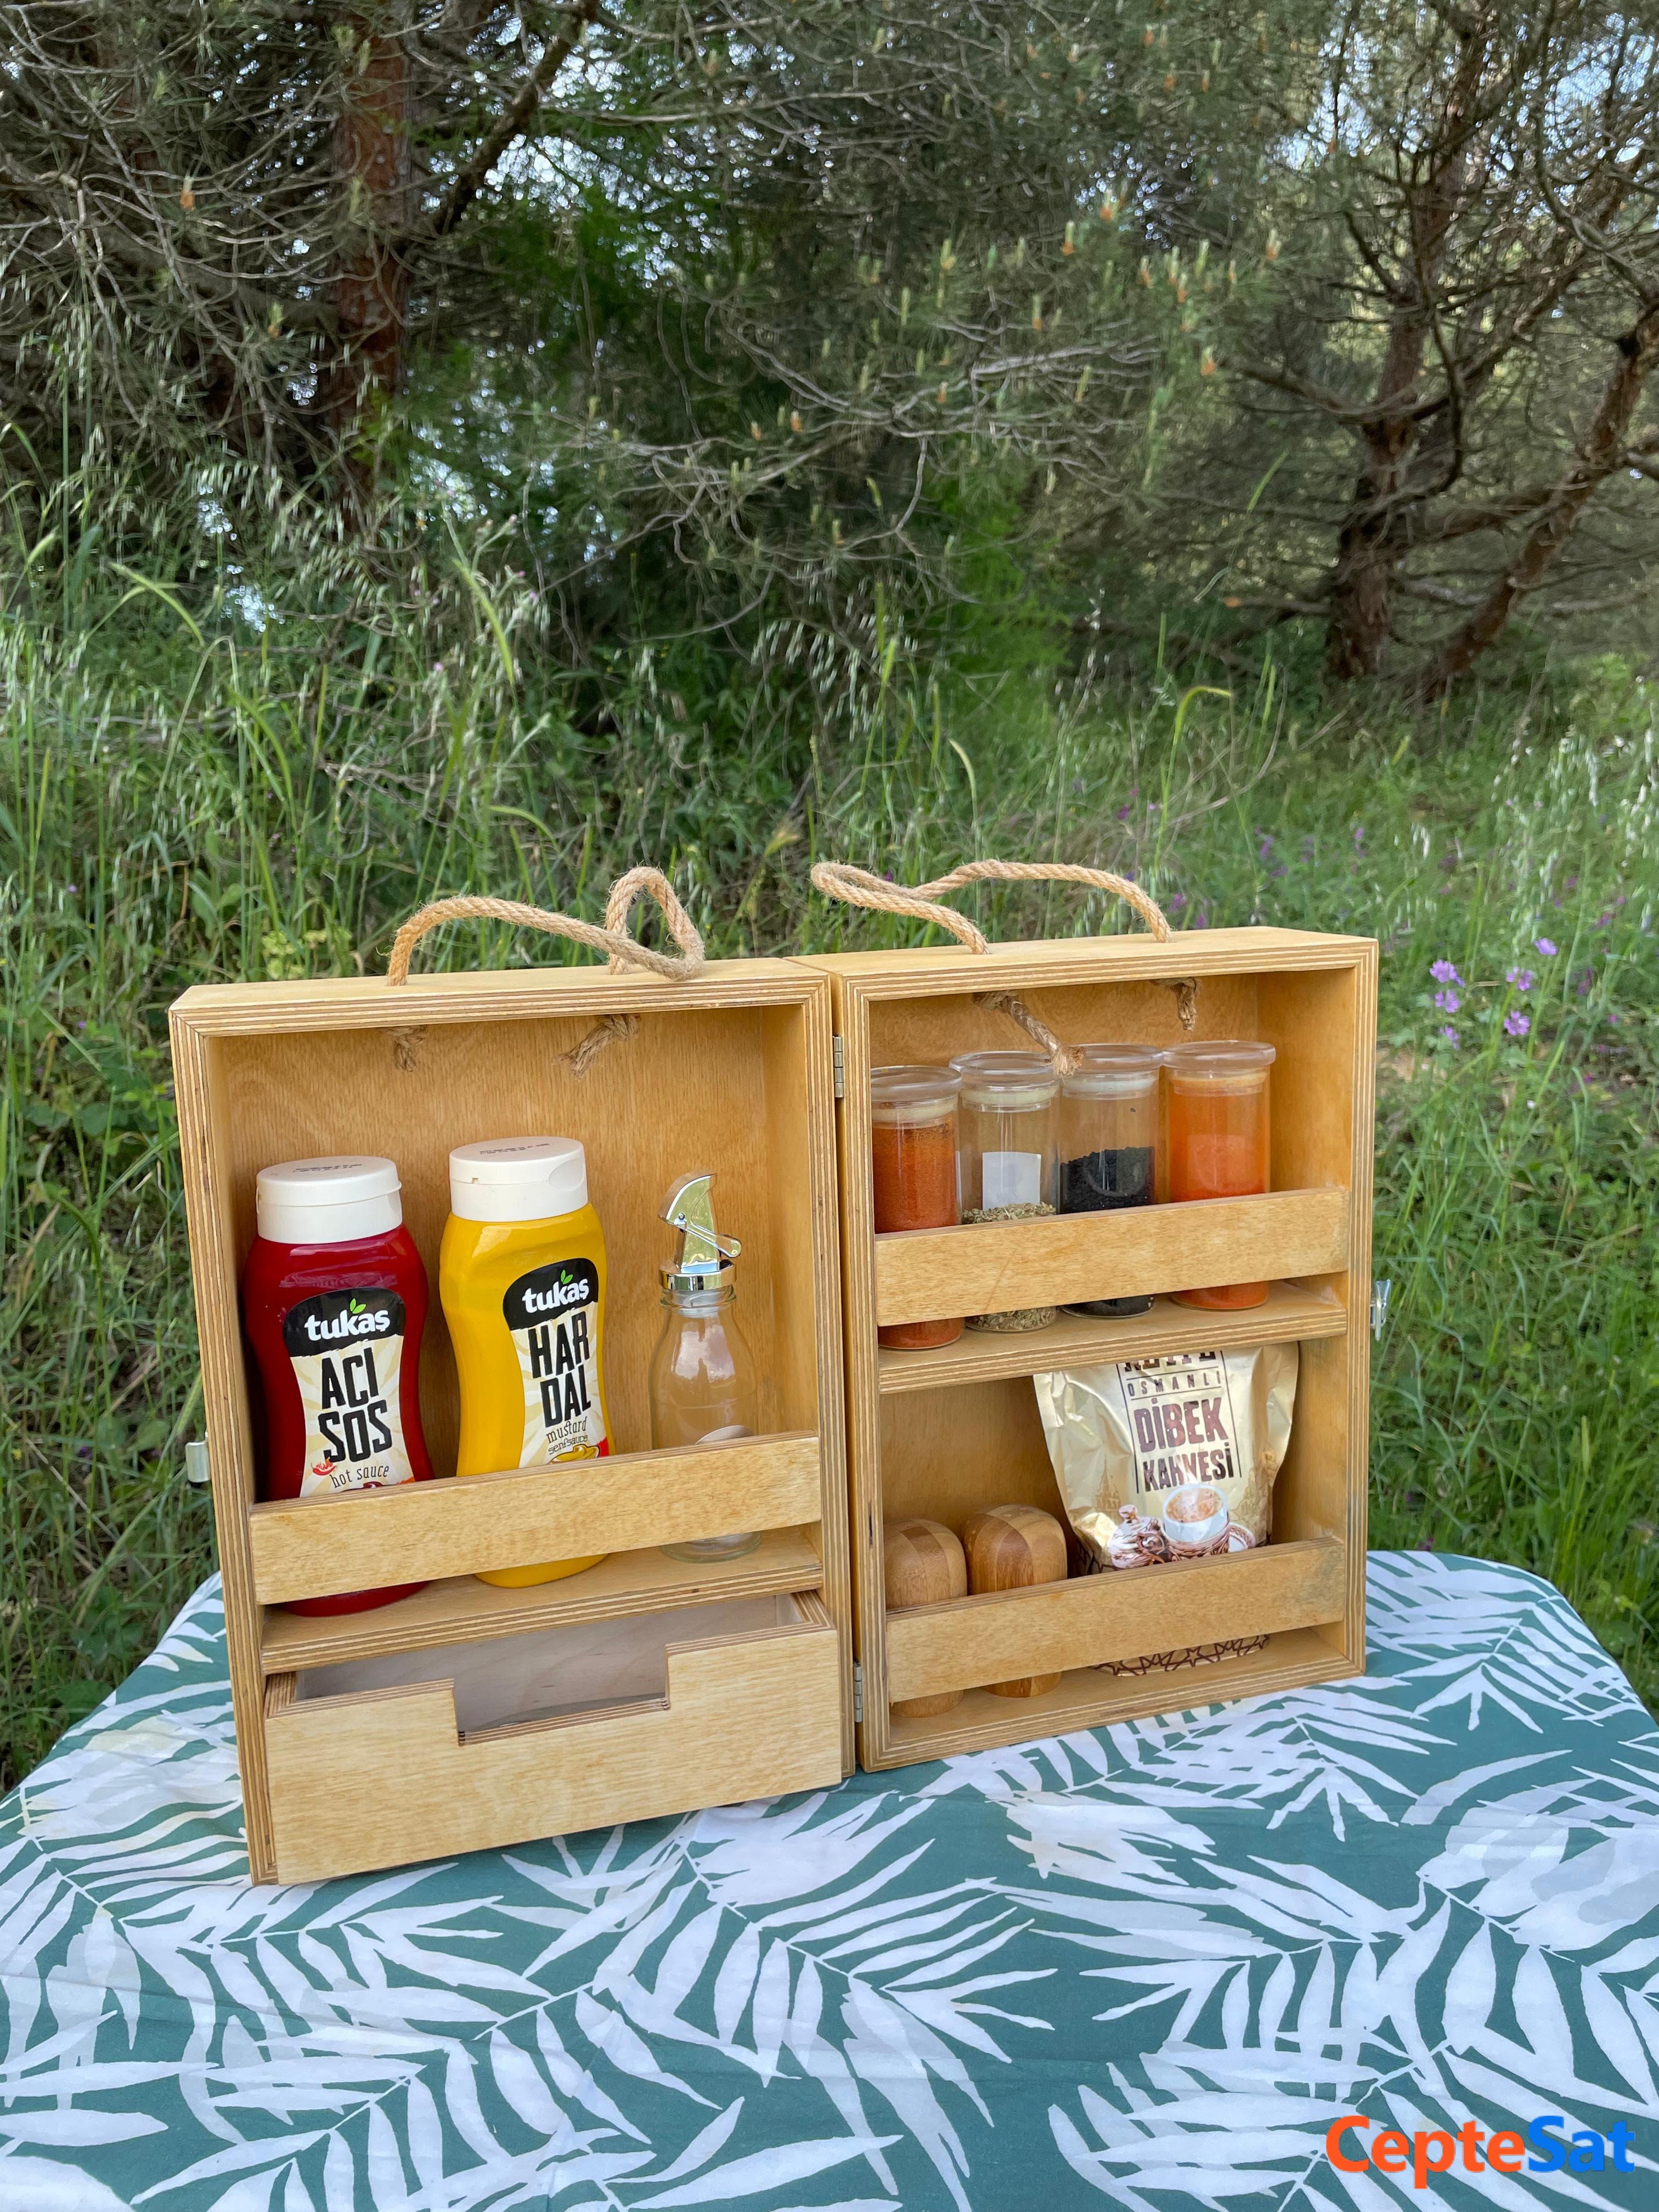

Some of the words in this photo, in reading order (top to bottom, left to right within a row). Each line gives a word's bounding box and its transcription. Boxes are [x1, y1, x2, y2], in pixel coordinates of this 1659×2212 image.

[522, 1278, 589, 1313] tukaş
[304, 1310, 390, 1341] tukaş
[528, 1311, 590, 1379] HAR
[321, 1347, 379, 1409] ACI
[540, 1363, 591, 1427] DAL
[1127, 1370, 1221, 1397] OSMANLI
[318, 1400, 392, 1463] SOS
[546, 1416, 588, 1444] mustard
[1133, 1397, 1228, 1453] DİBEK
[330, 1469, 353, 1488] hot
[357, 1465, 389, 1480] sauce
[1143, 1442, 1234, 1492] KAHVESİ
